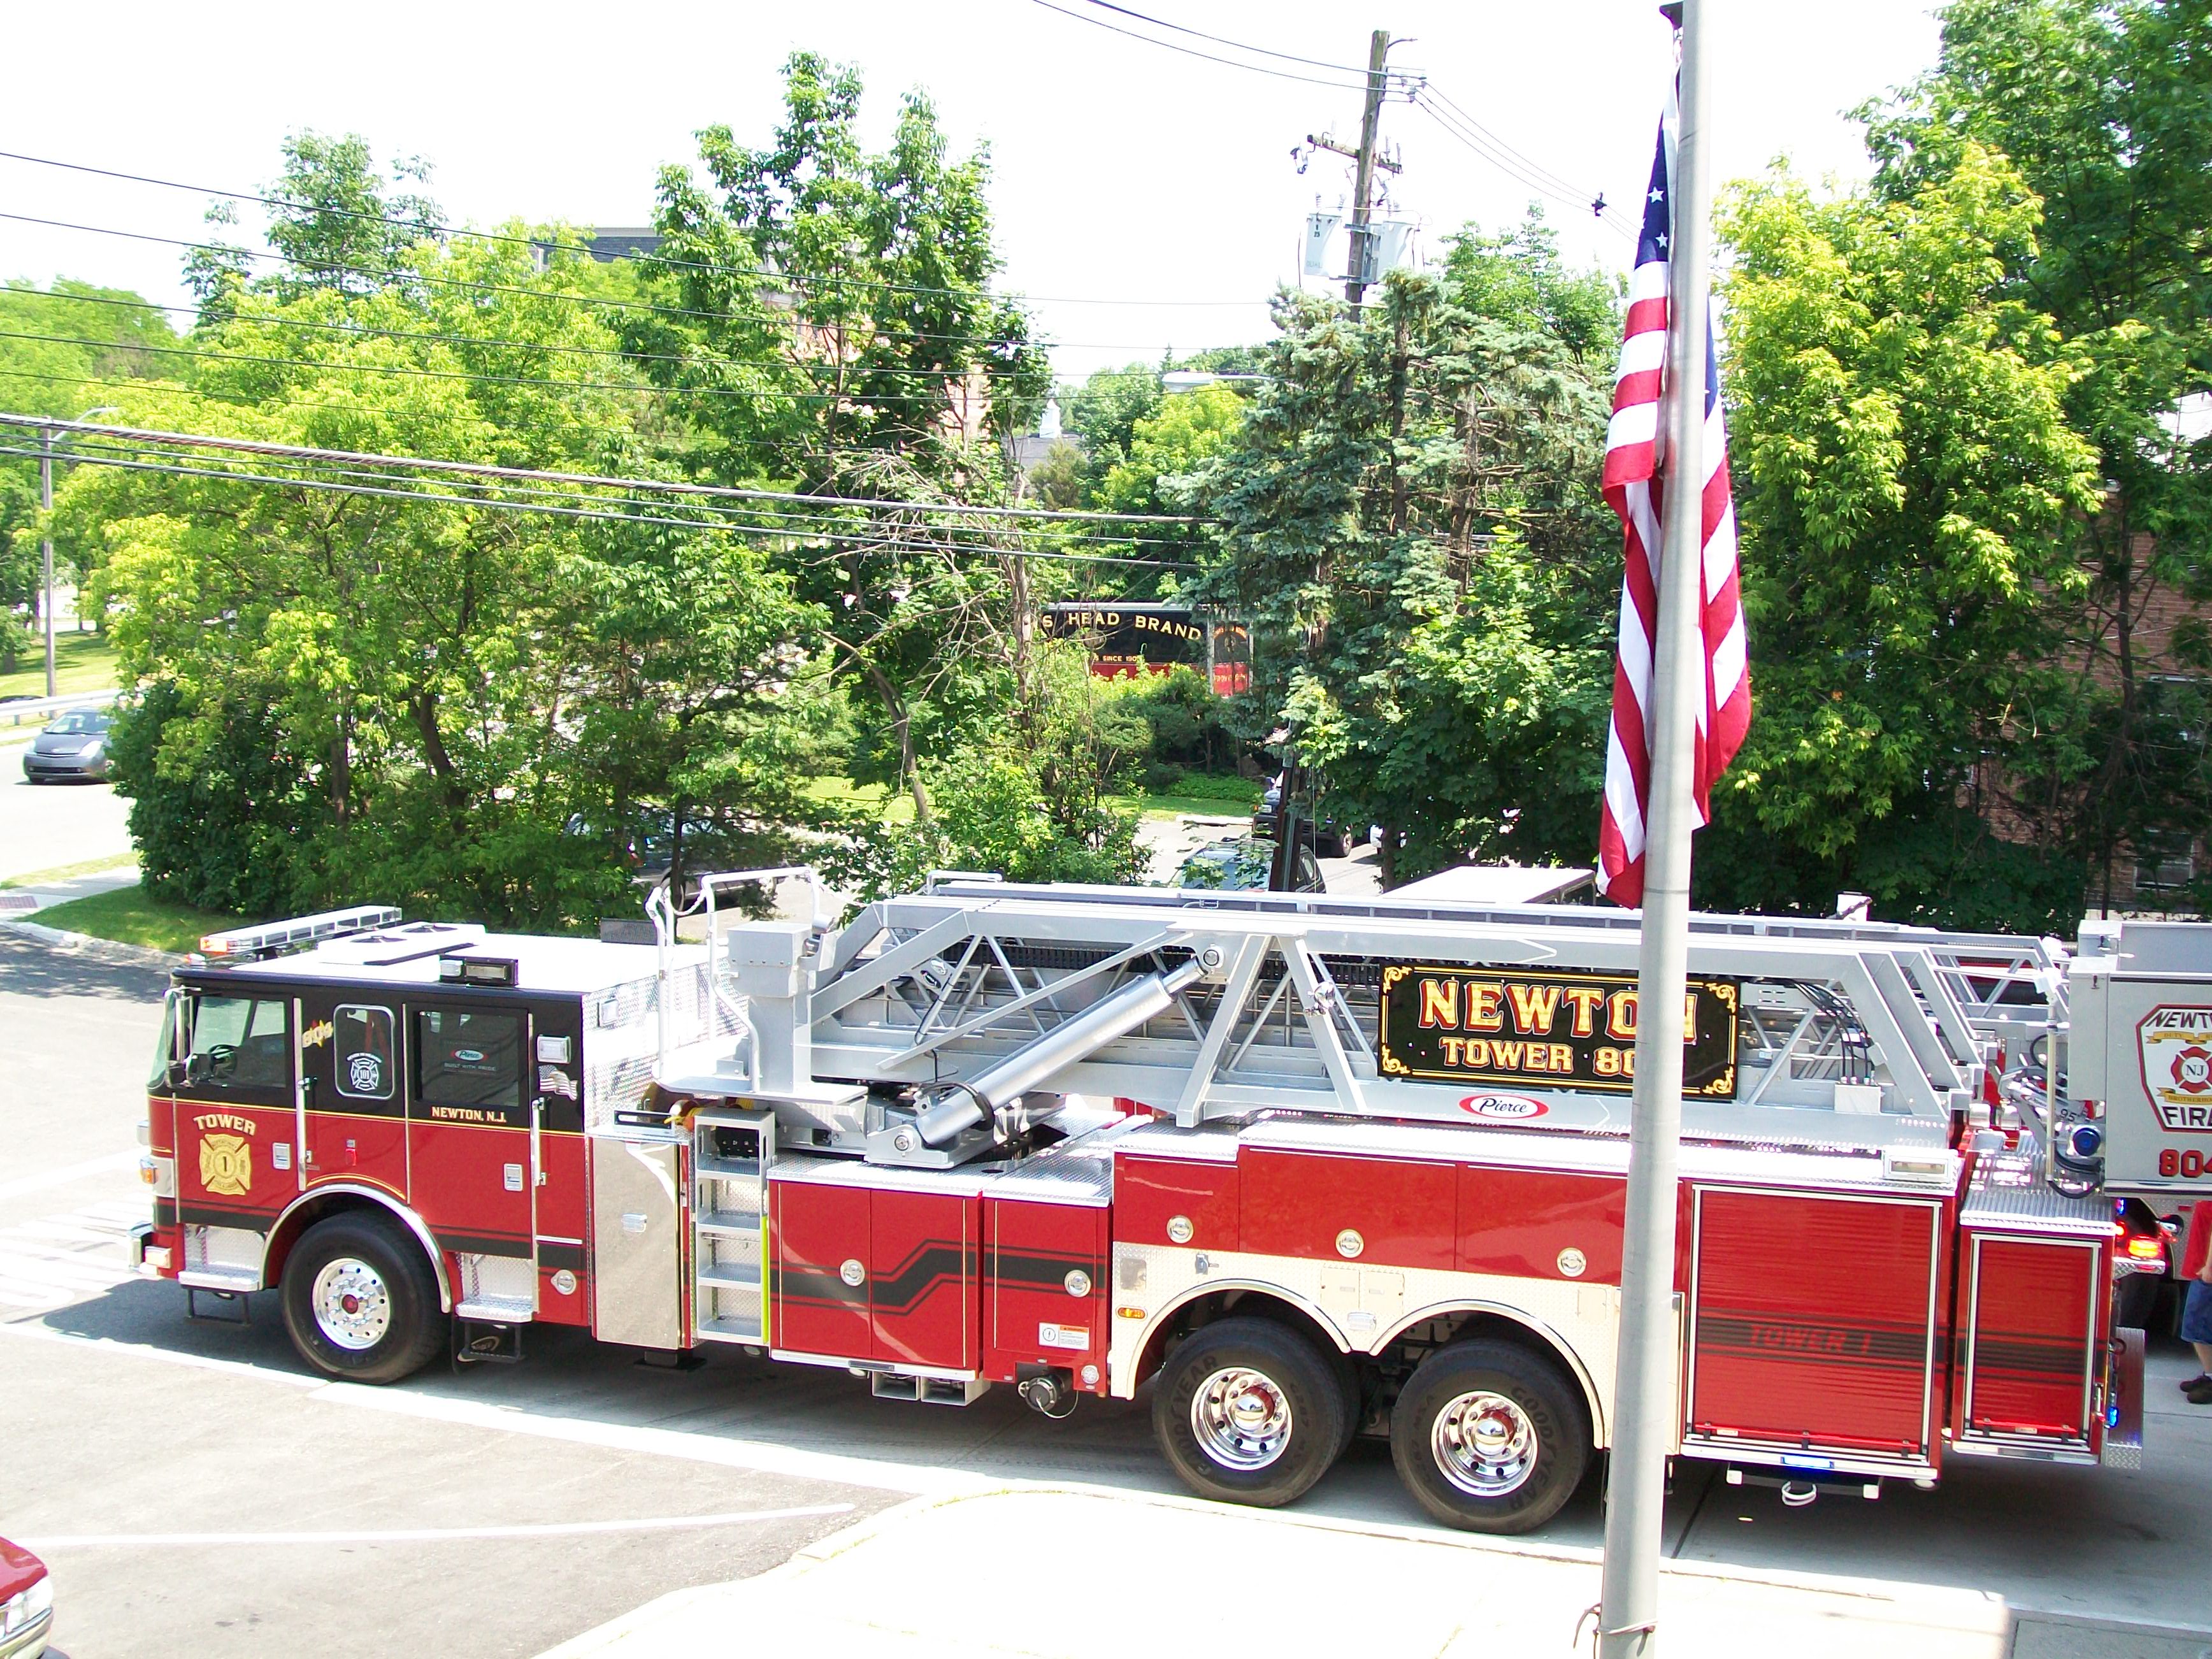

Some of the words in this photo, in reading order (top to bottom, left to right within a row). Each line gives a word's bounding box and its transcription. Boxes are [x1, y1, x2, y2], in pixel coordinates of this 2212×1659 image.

[1068, 612, 1120, 626] HEAD
[1135, 615, 1202, 641] BRAND
[2145, 1010, 2212, 1029] NEWT
[459, 1050, 480, 1059] Pierce
[1439, 1037, 1574, 1074] TOWER
[1593, 1046, 1636, 1078] 80
[2185, 1064, 2205, 1076] NJ
[1479, 1098, 1528, 1113] Pierce
[193, 1114, 256, 1136] TOWER
[2162, 1106, 2212, 1127] FIR
[1749, 1325, 1847, 1351] TOWER
[1510, 1386, 1557, 1510] GOODYEAR
